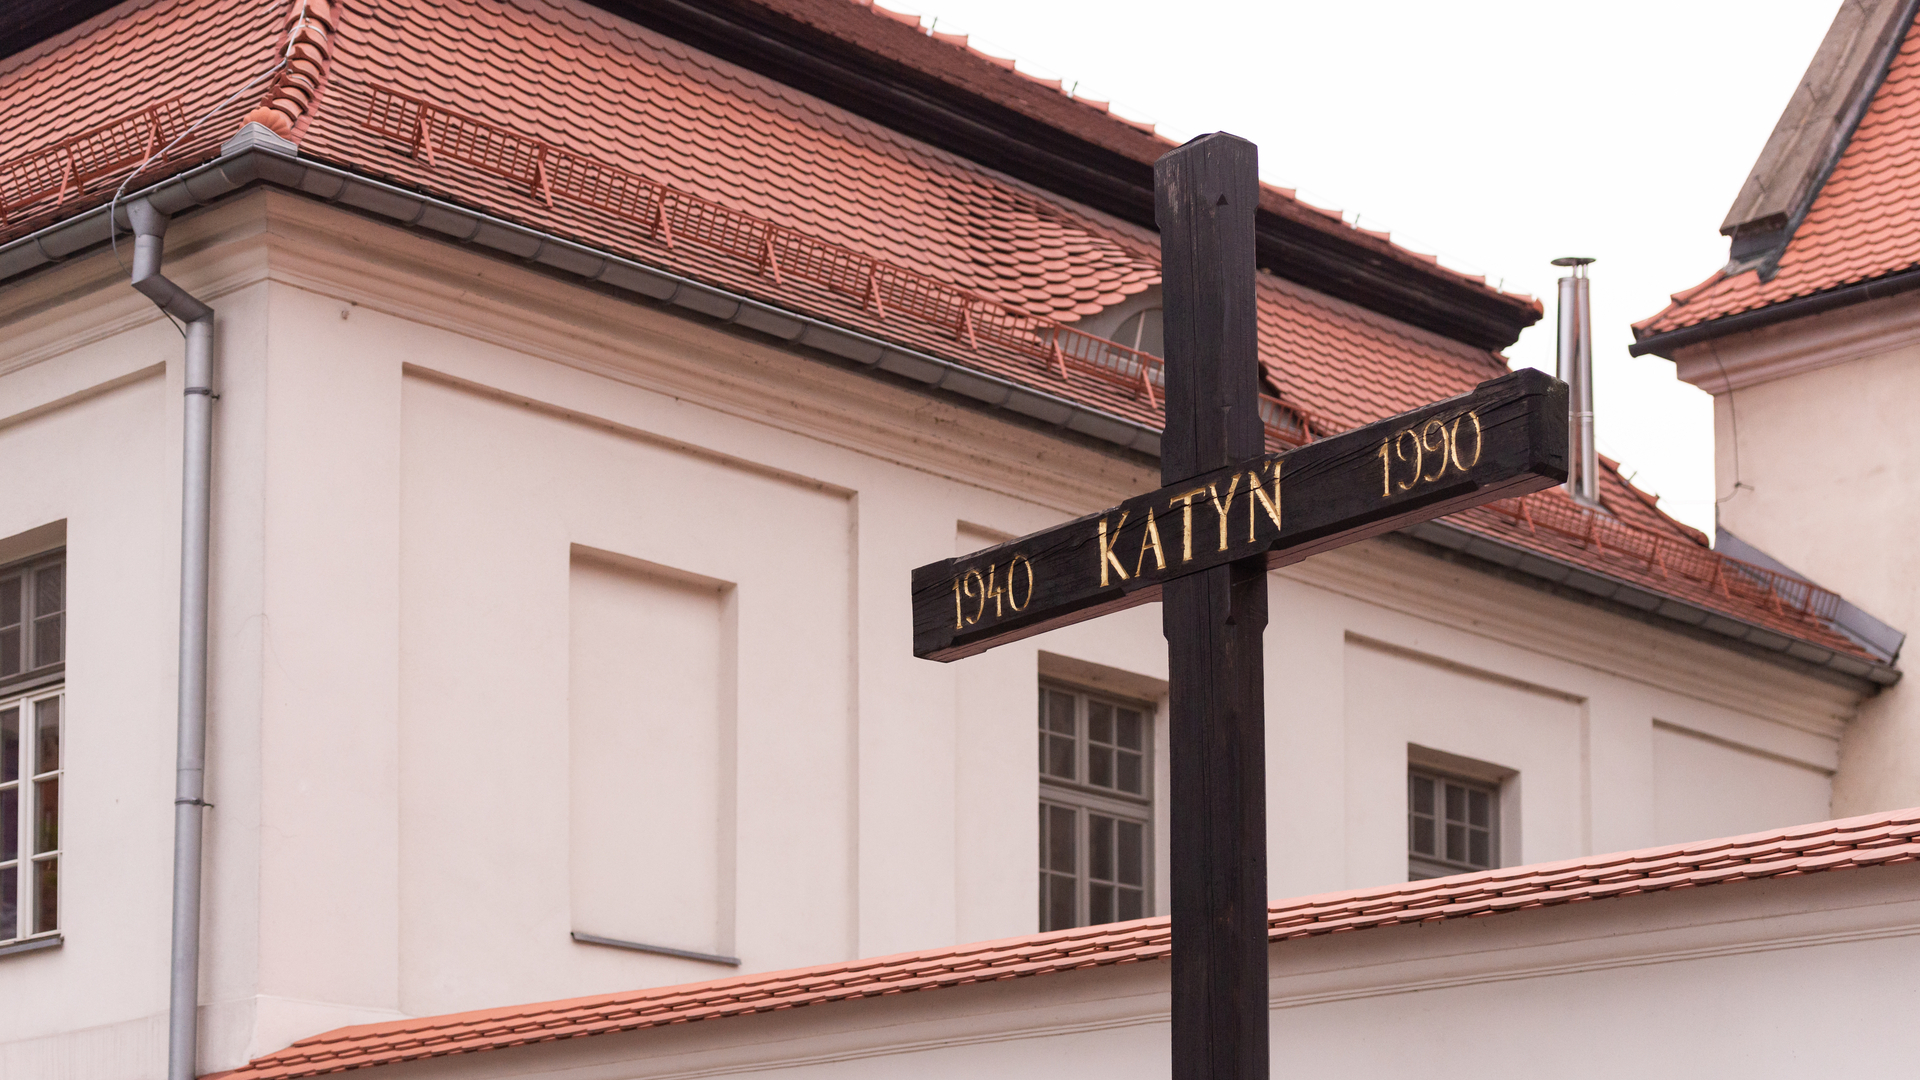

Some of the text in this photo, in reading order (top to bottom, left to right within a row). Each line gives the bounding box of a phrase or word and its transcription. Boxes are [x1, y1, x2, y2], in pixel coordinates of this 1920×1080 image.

[952, 410, 1482, 630] 1940 KATYŃ 1990
